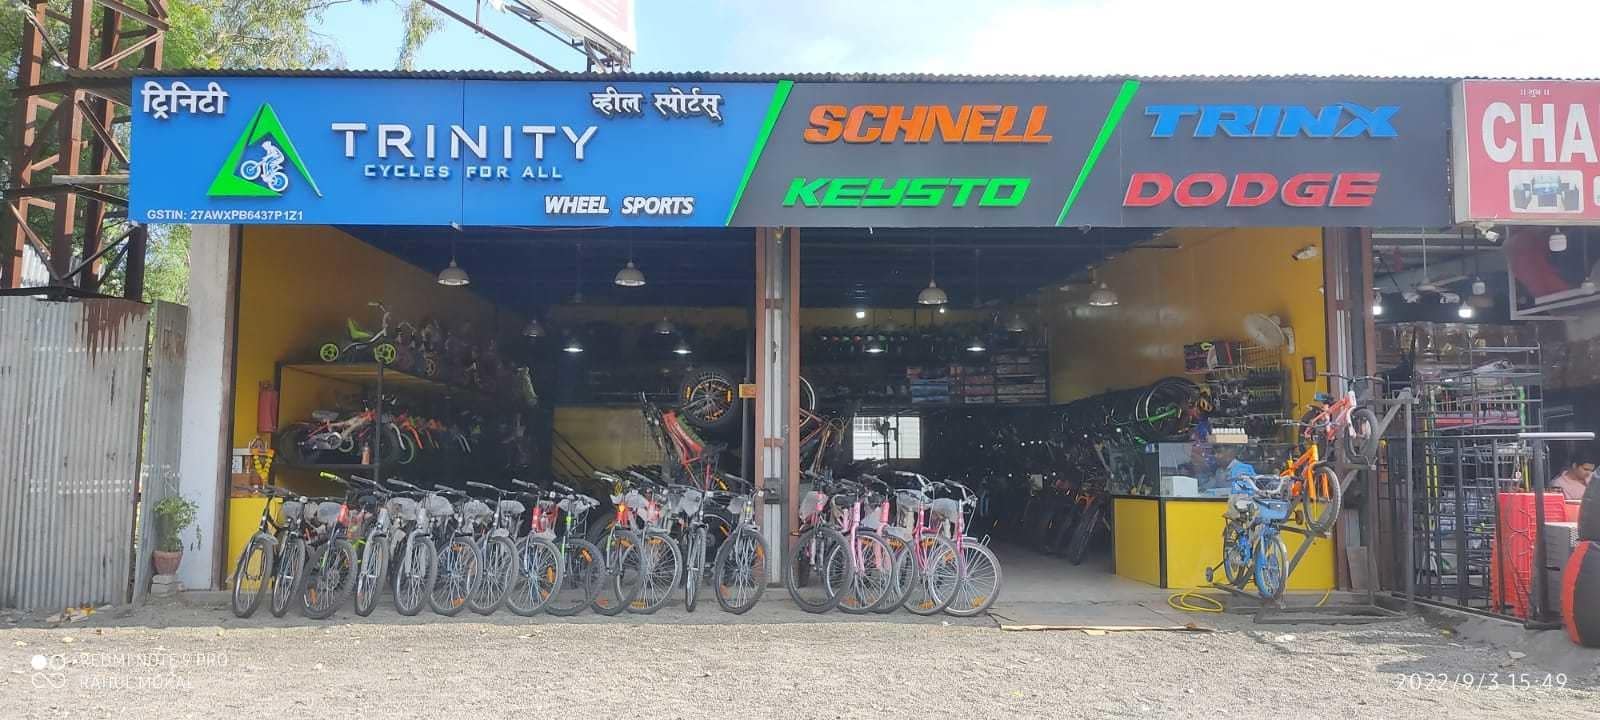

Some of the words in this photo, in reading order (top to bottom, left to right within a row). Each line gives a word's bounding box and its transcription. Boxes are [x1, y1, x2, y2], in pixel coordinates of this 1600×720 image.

[140, 80, 229, 119] ट्रिनिटी
[591, 87, 643, 115] व्हील
[803, 104, 1053, 144] SCHNELL
[1144, 102, 1401, 139] TRINX
[1481, 101, 1600, 163] CHA
[331, 122, 599, 161] TRINITY
[363, 164, 449, 179] CYCLES
[465, 165, 510, 179] FOR
[521, 165, 563, 179] ALL
[544, 195, 610, 215] WHEEL
[621, 195, 694, 216] SPORTS
[782, 177, 1032, 208] KEYSTO
[1122, 172, 1381, 208] DODGE
[146, 209, 187, 220] GSTIN:
[190, 209, 303, 221] 27AWXPB6437P1Z1
